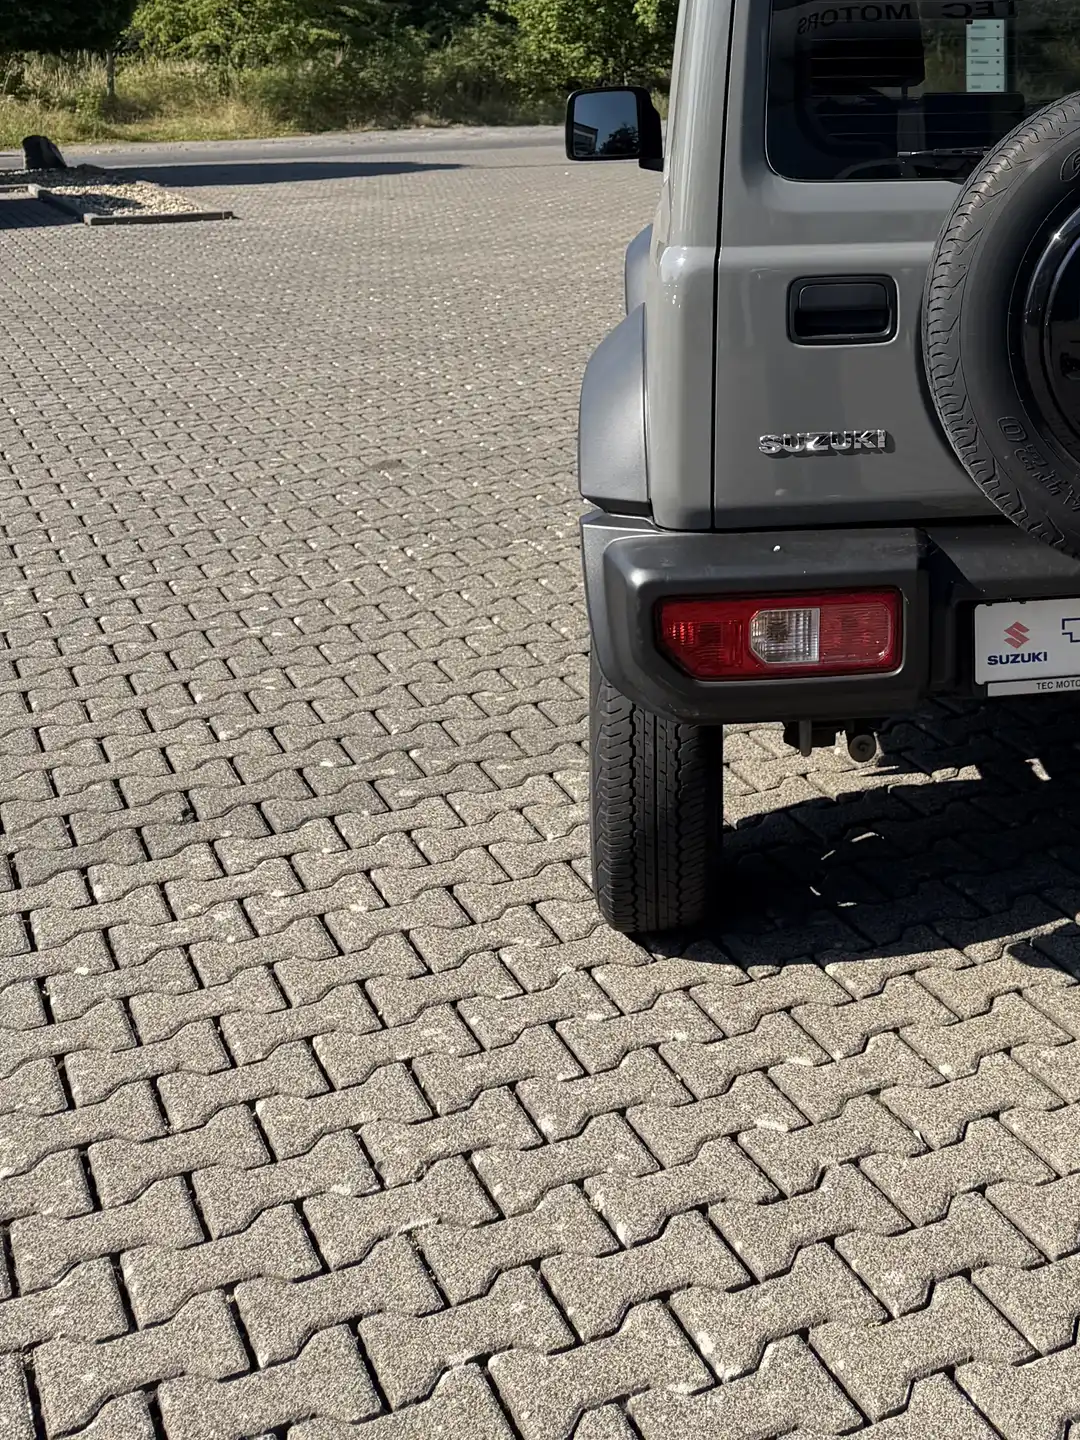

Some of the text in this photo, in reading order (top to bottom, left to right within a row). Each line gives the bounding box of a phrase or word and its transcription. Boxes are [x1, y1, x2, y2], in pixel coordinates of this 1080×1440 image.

[759, 429, 887, 454] SUZUKI
[987, 651, 1048, 666] SUZUKI
[1036, 681, 1054, 690] TEC
